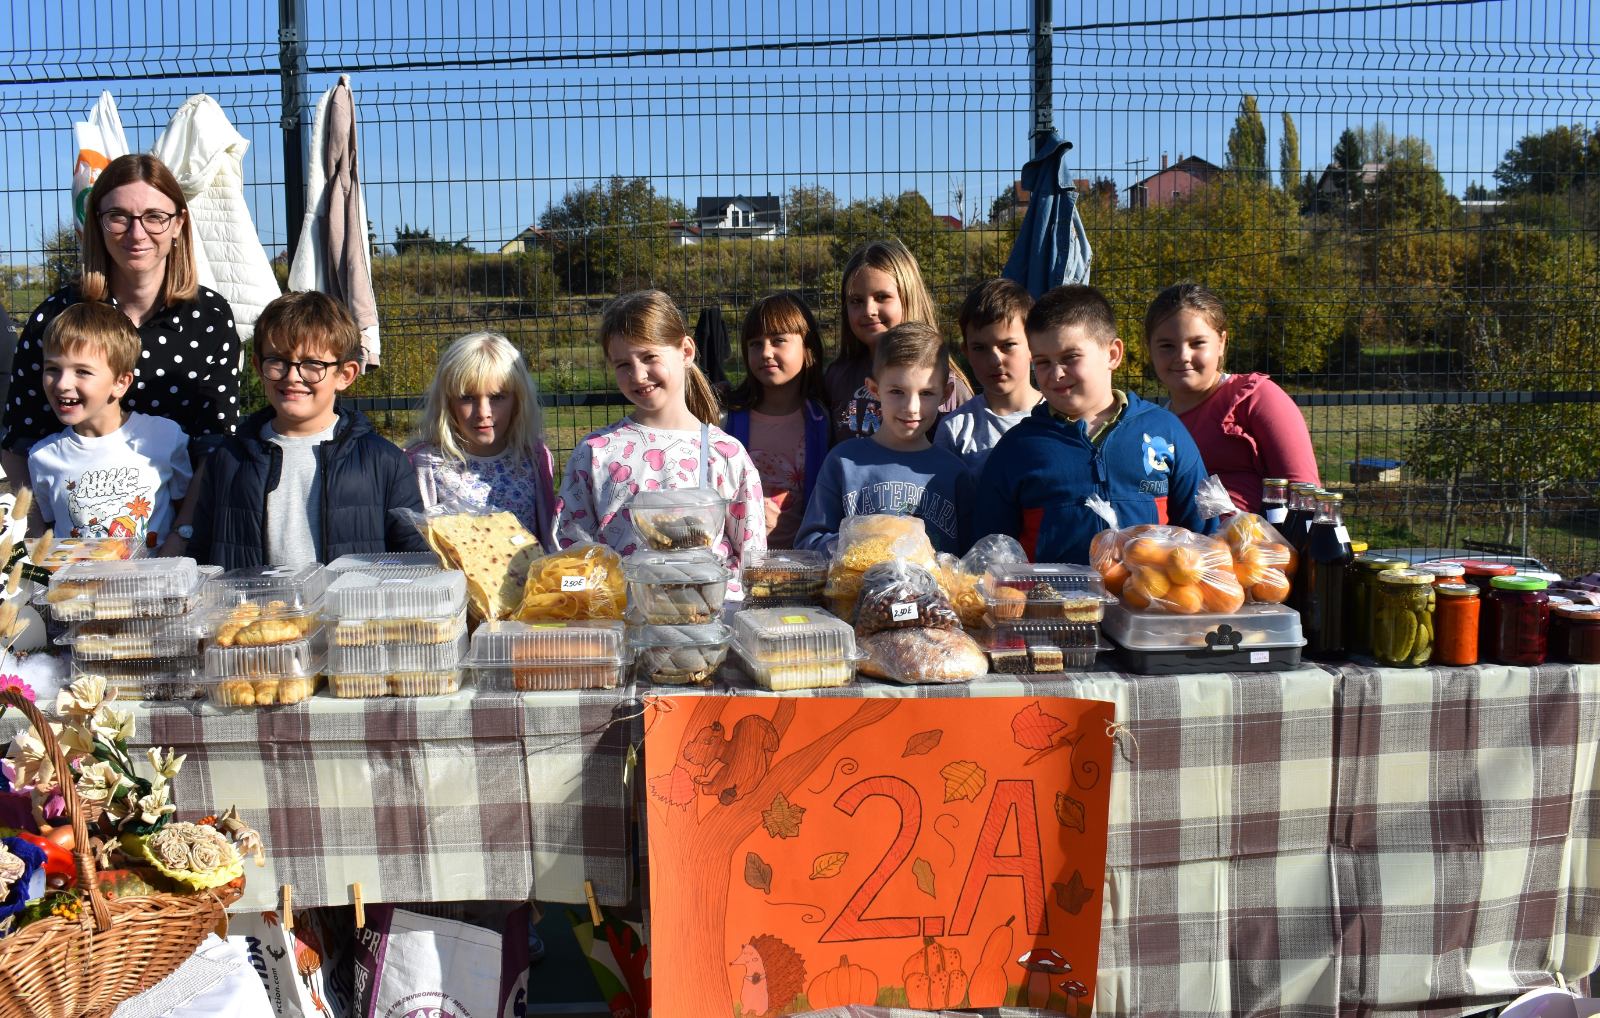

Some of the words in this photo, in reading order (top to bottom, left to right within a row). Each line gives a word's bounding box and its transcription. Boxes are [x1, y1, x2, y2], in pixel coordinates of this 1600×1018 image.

[818, 775, 1049, 943] 2.A
[361, 928, 380, 964] PR
[272, 967, 283, 1014] action.com
[401, 991, 450, 1003] ENVIRONMENT
